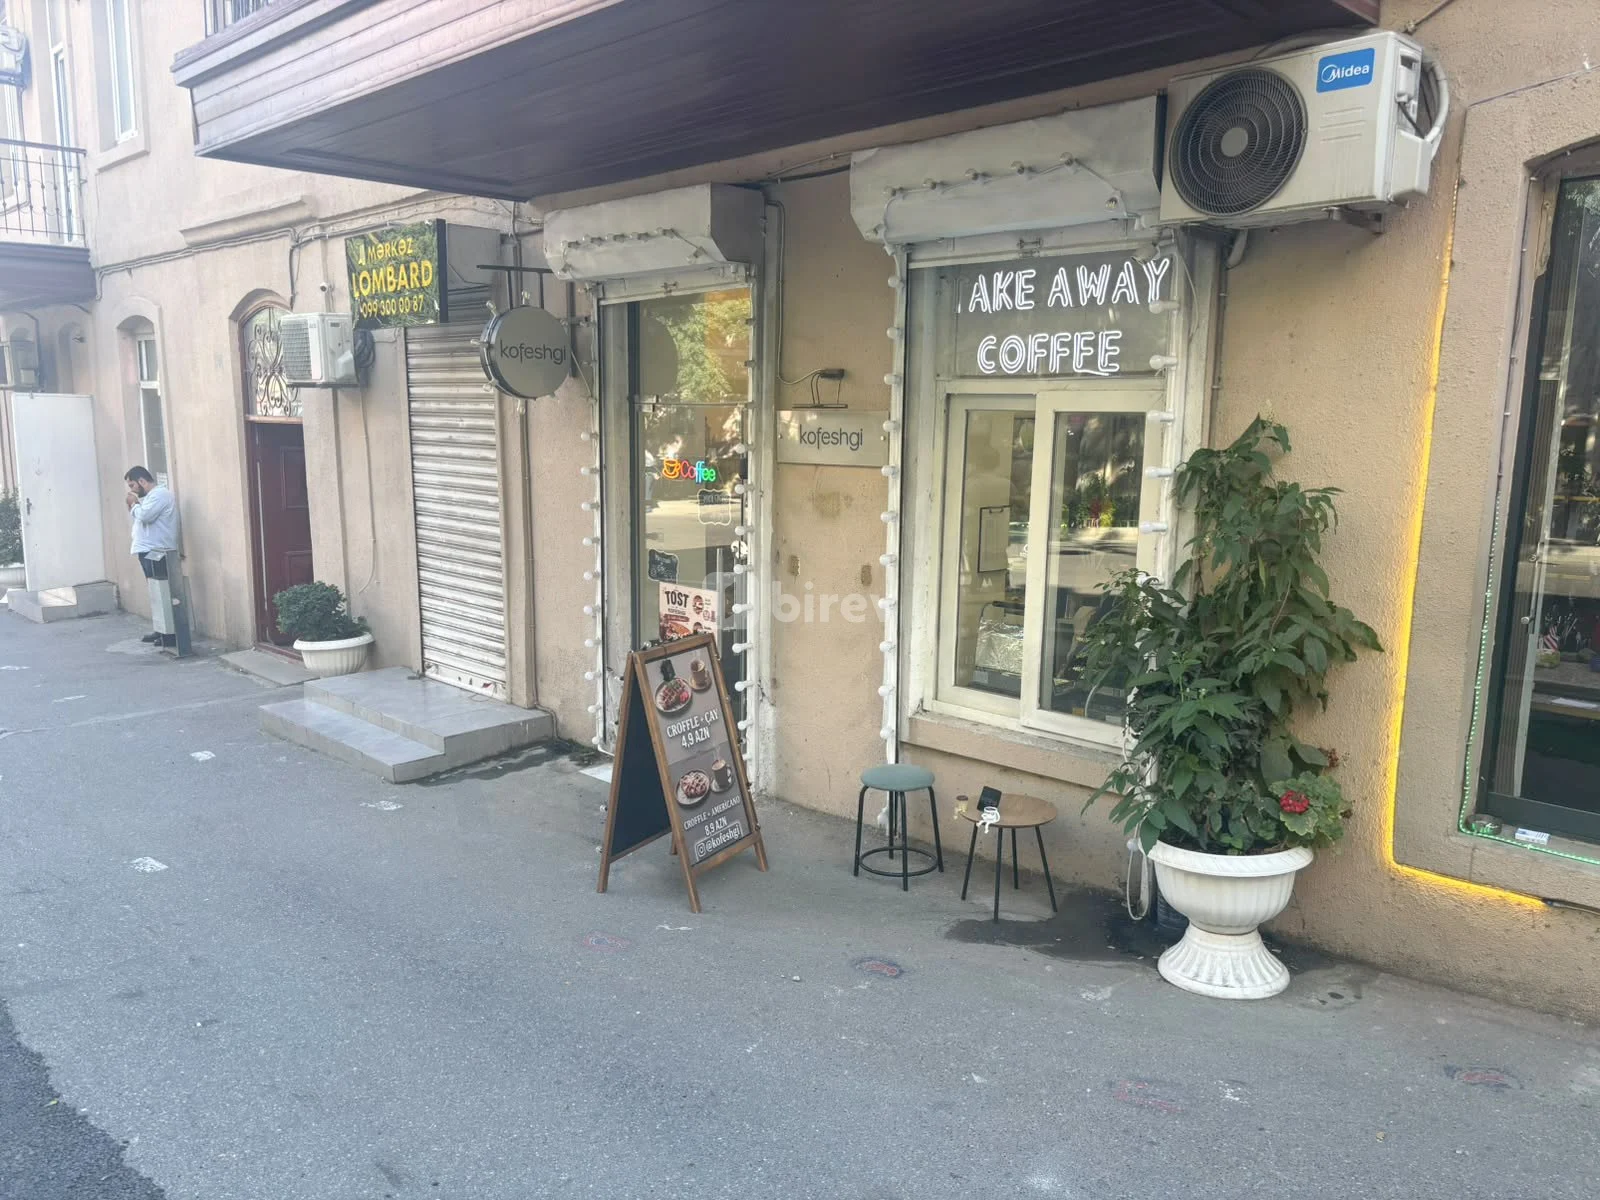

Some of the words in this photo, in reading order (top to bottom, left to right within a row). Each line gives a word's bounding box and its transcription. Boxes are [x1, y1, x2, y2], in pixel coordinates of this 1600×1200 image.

[1324, 64, 1370, 82] Midea
[352, 259, 433, 298] LOMBARD
[1048, 257, 1170, 308] AWAY
[361, 299, 378, 319] 099
[380, 298, 397, 316] 300
[399, 296, 411, 313] 00
[412, 294, 424, 312] 87
[500, 340, 567, 365] kofeshgi
[976, 330, 1123, 376] COFFEE
[799, 423, 864, 451] kofeshgi
[680, 460, 717, 484] Coffee
[664, 590, 690, 608] TOST
[666, 715, 700, 738] CROFFLE
[704, 708, 719, 725] ÇAY
[681, 732, 695, 748] 4,9
[695, 726, 711, 743] AZN
[683, 811, 707, 831] CROFFLE
[715, 816, 728, 831] AZN
[705, 824, 741, 852] @kofeshgi
